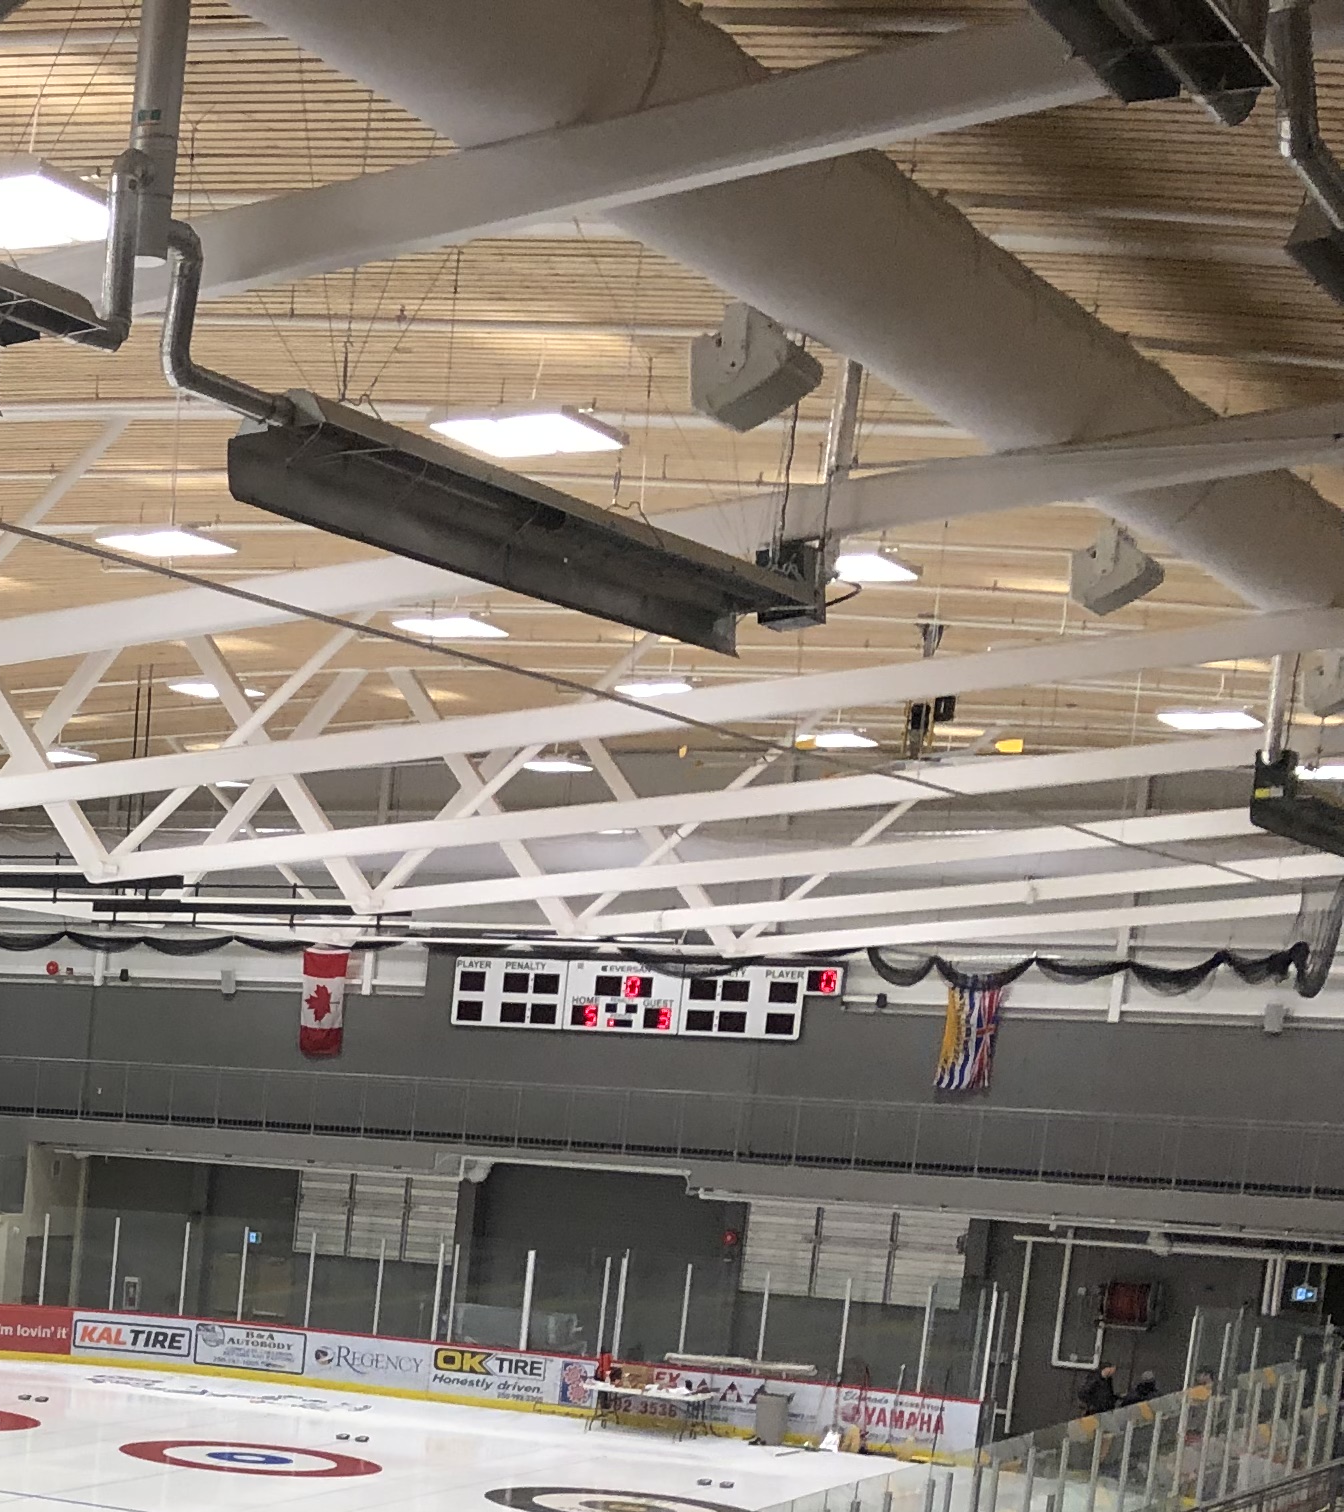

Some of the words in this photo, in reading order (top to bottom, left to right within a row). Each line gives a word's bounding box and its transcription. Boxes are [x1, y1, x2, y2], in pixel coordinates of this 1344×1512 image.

[456, 960, 492, 969] PLAYER
[505, 961, 547, 970] PENALTY
[765, 970, 805, 979] PLAYER
[572, 996, 600, 1005] HOME
[642, 999, 674, 1008] GUEST
[16, 1324, 54, 1339] lovin'
[56, 1326, 67, 1339] it
[79, 1324, 127, 1347] KAL
[129, 1328, 186, 1351] TIRE
[227, 1337, 293, 1351] AUTOBODY
[336, 1345, 423, 1375] REGENCY
[436, 1349, 492, 1373] OK
[496, 1356, 543, 1378] TIRE
[432, 1374, 494, 1391] Honestly
[497, 1380, 544, 1395] driven.
[864, 1405, 945, 1435] YAMAHA
